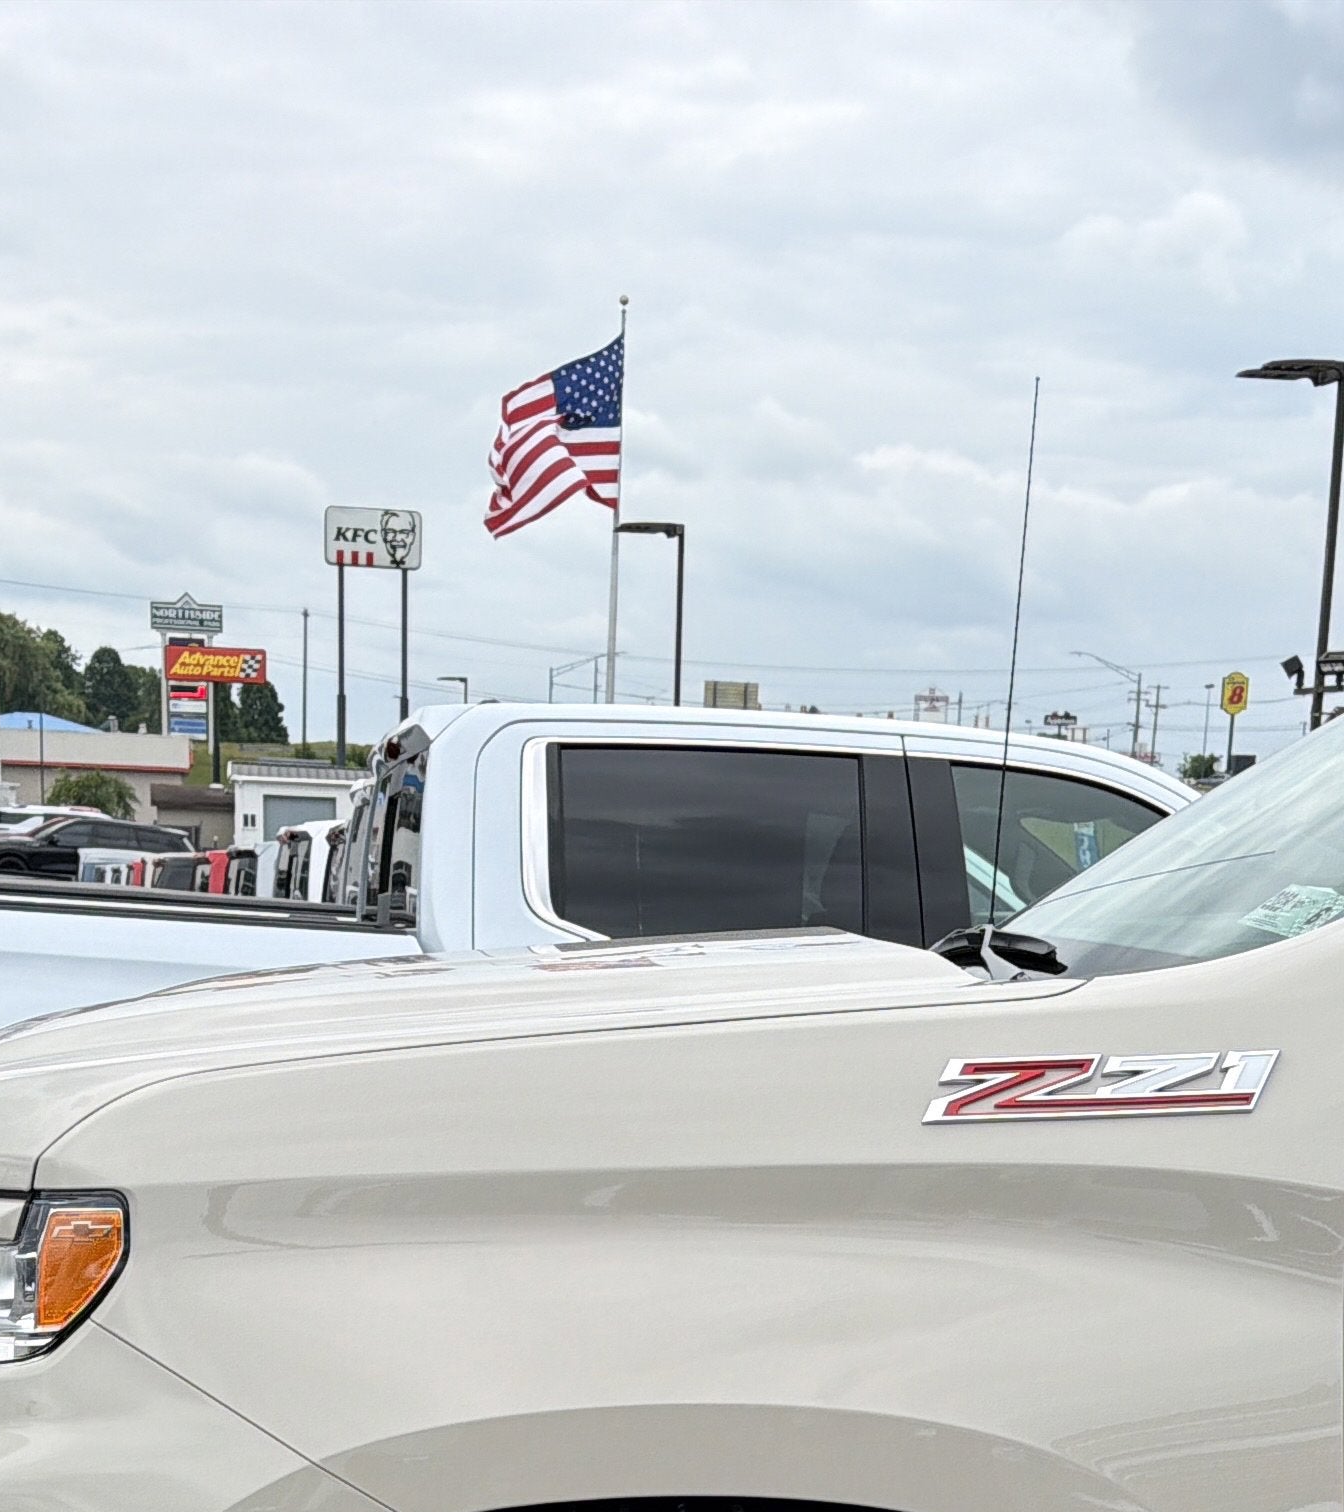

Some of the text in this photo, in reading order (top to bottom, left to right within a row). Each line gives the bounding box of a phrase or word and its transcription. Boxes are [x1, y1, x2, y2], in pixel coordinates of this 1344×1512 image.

[333, 526, 378, 545] KFC
[177, 651, 238, 666] Advance
[170, 664, 235, 677] Auto Parts
[1228, 685, 1245, 705] 8
[922, 1050, 1281, 1125] Z71
